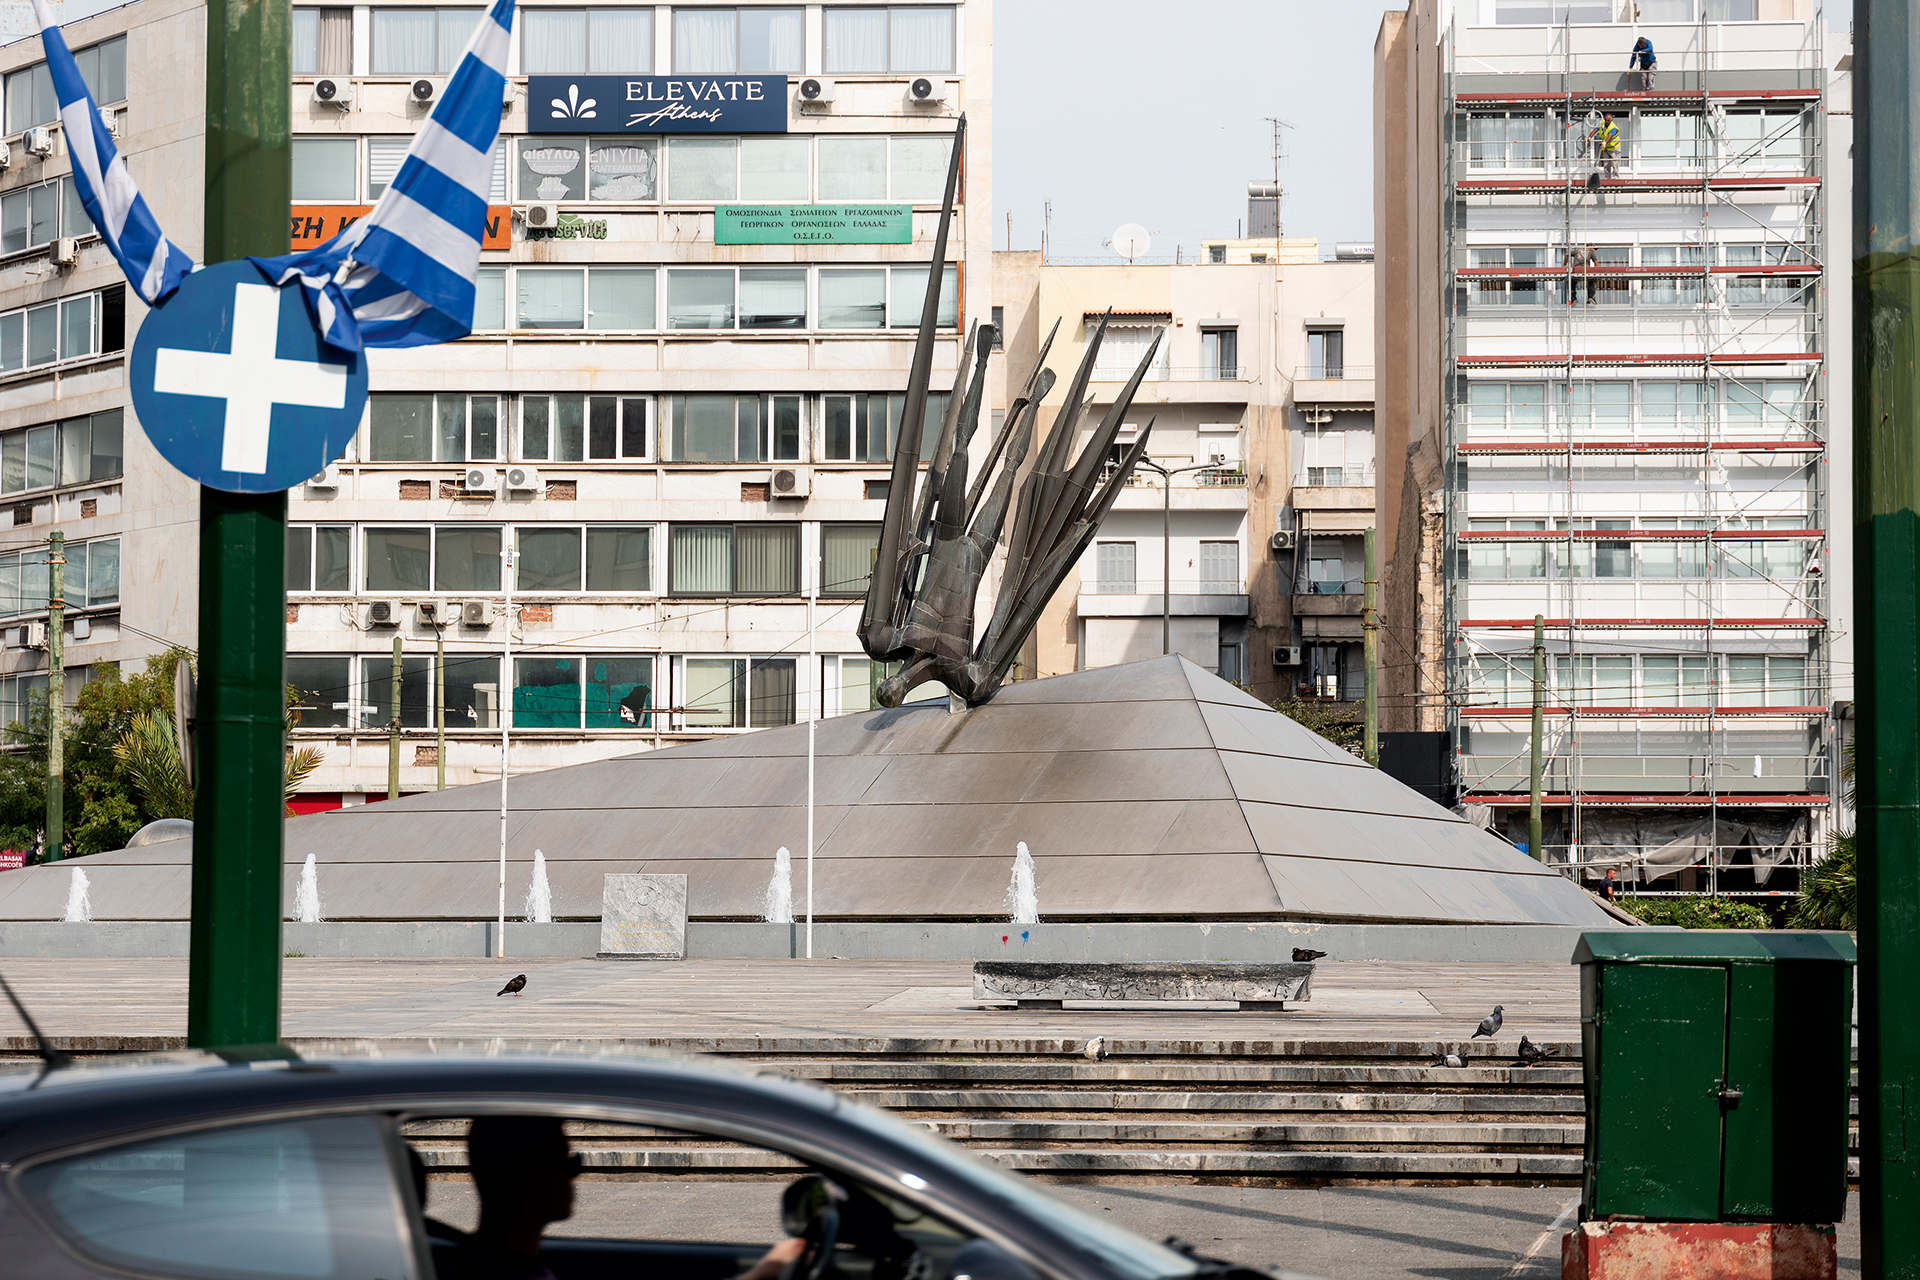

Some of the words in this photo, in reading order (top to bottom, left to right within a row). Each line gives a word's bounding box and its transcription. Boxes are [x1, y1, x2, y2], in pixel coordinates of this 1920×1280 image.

[625, 80, 765, 101] ELEVATE
[625, 101, 723, 127] Athens
[725, 209, 782, 217] ΟΜΟΣΠΟΝΔΙΑ
[790, 209, 838, 217] ΣΩΜΑΤΕΙΩΝ
